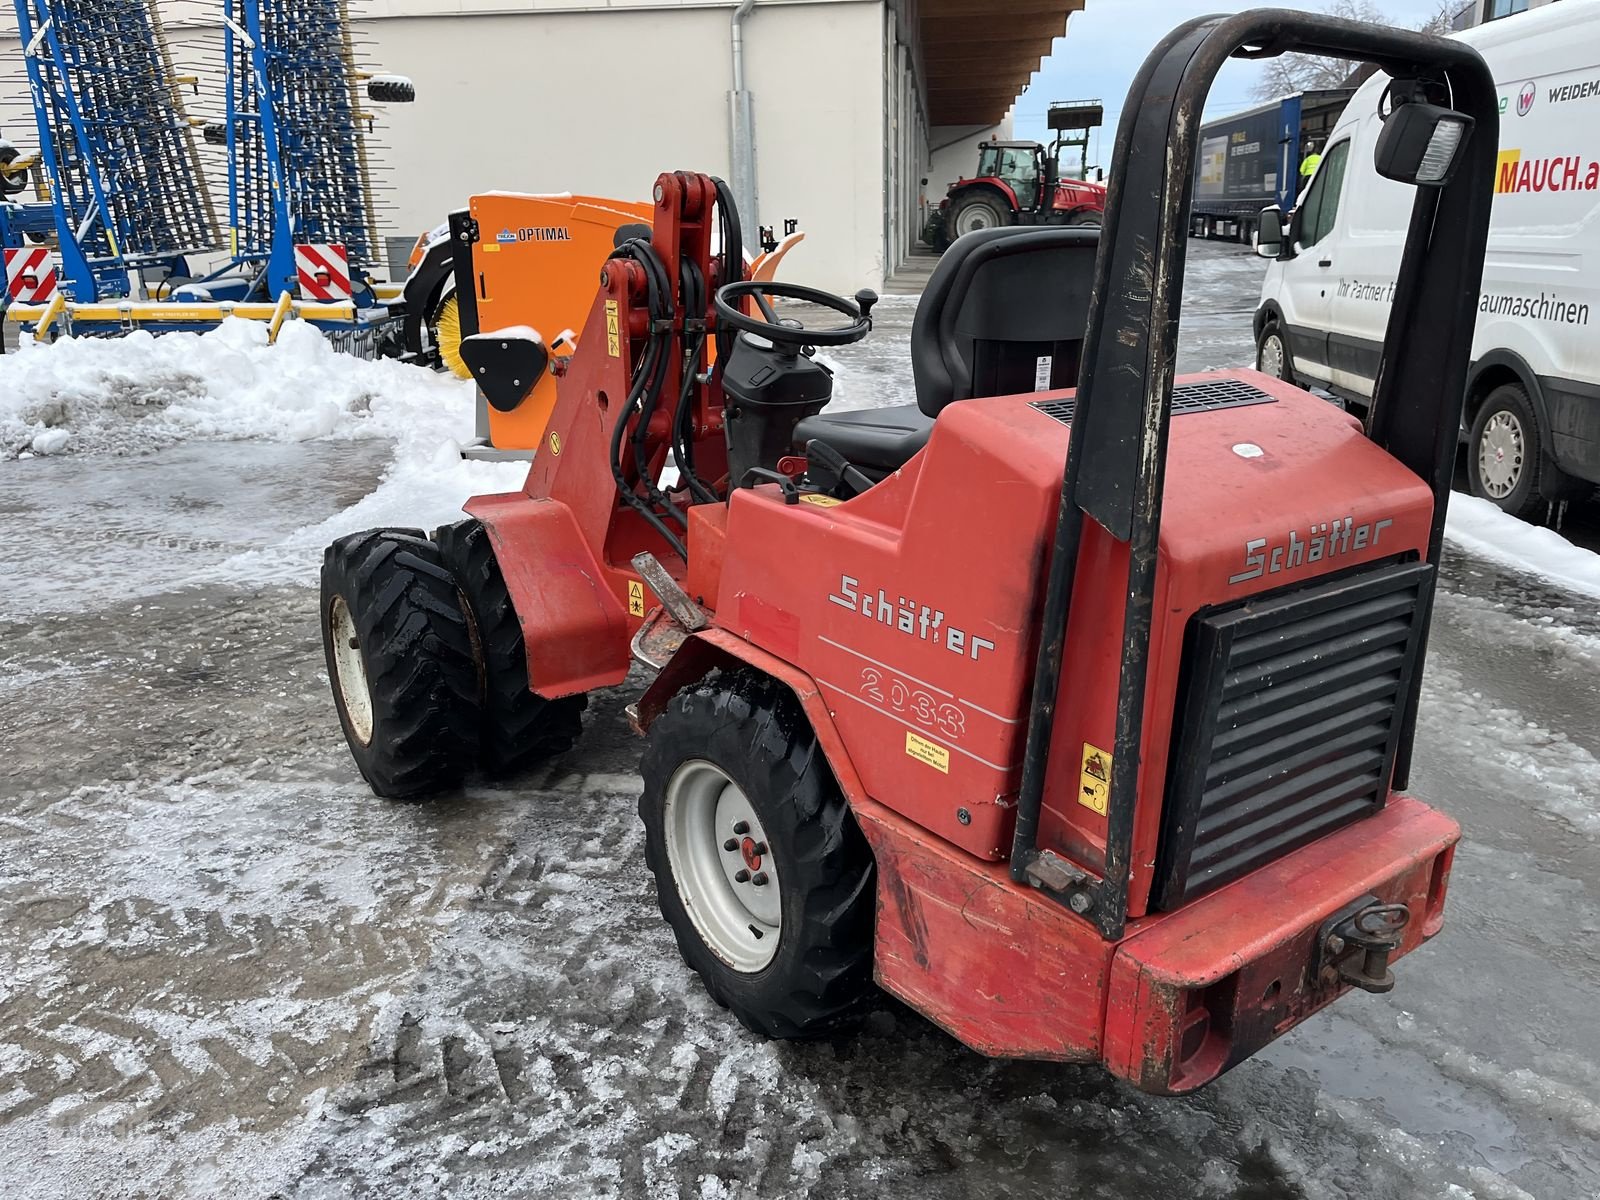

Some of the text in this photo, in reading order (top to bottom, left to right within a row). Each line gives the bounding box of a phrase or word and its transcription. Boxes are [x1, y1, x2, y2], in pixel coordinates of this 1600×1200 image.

[1549, 80, 1600, 103] WEIDEM
[518, 227, 571, 241] OPTIMAL
[1337, 278, 1350, 297] Ihr
[1350, 280, 1387, 302] Partner
[1479, 291, 1589, 325] aumaschinen
[1228, 516, 1393, 586] Schäffer
[828, 574, 995, 661] Schäffer
